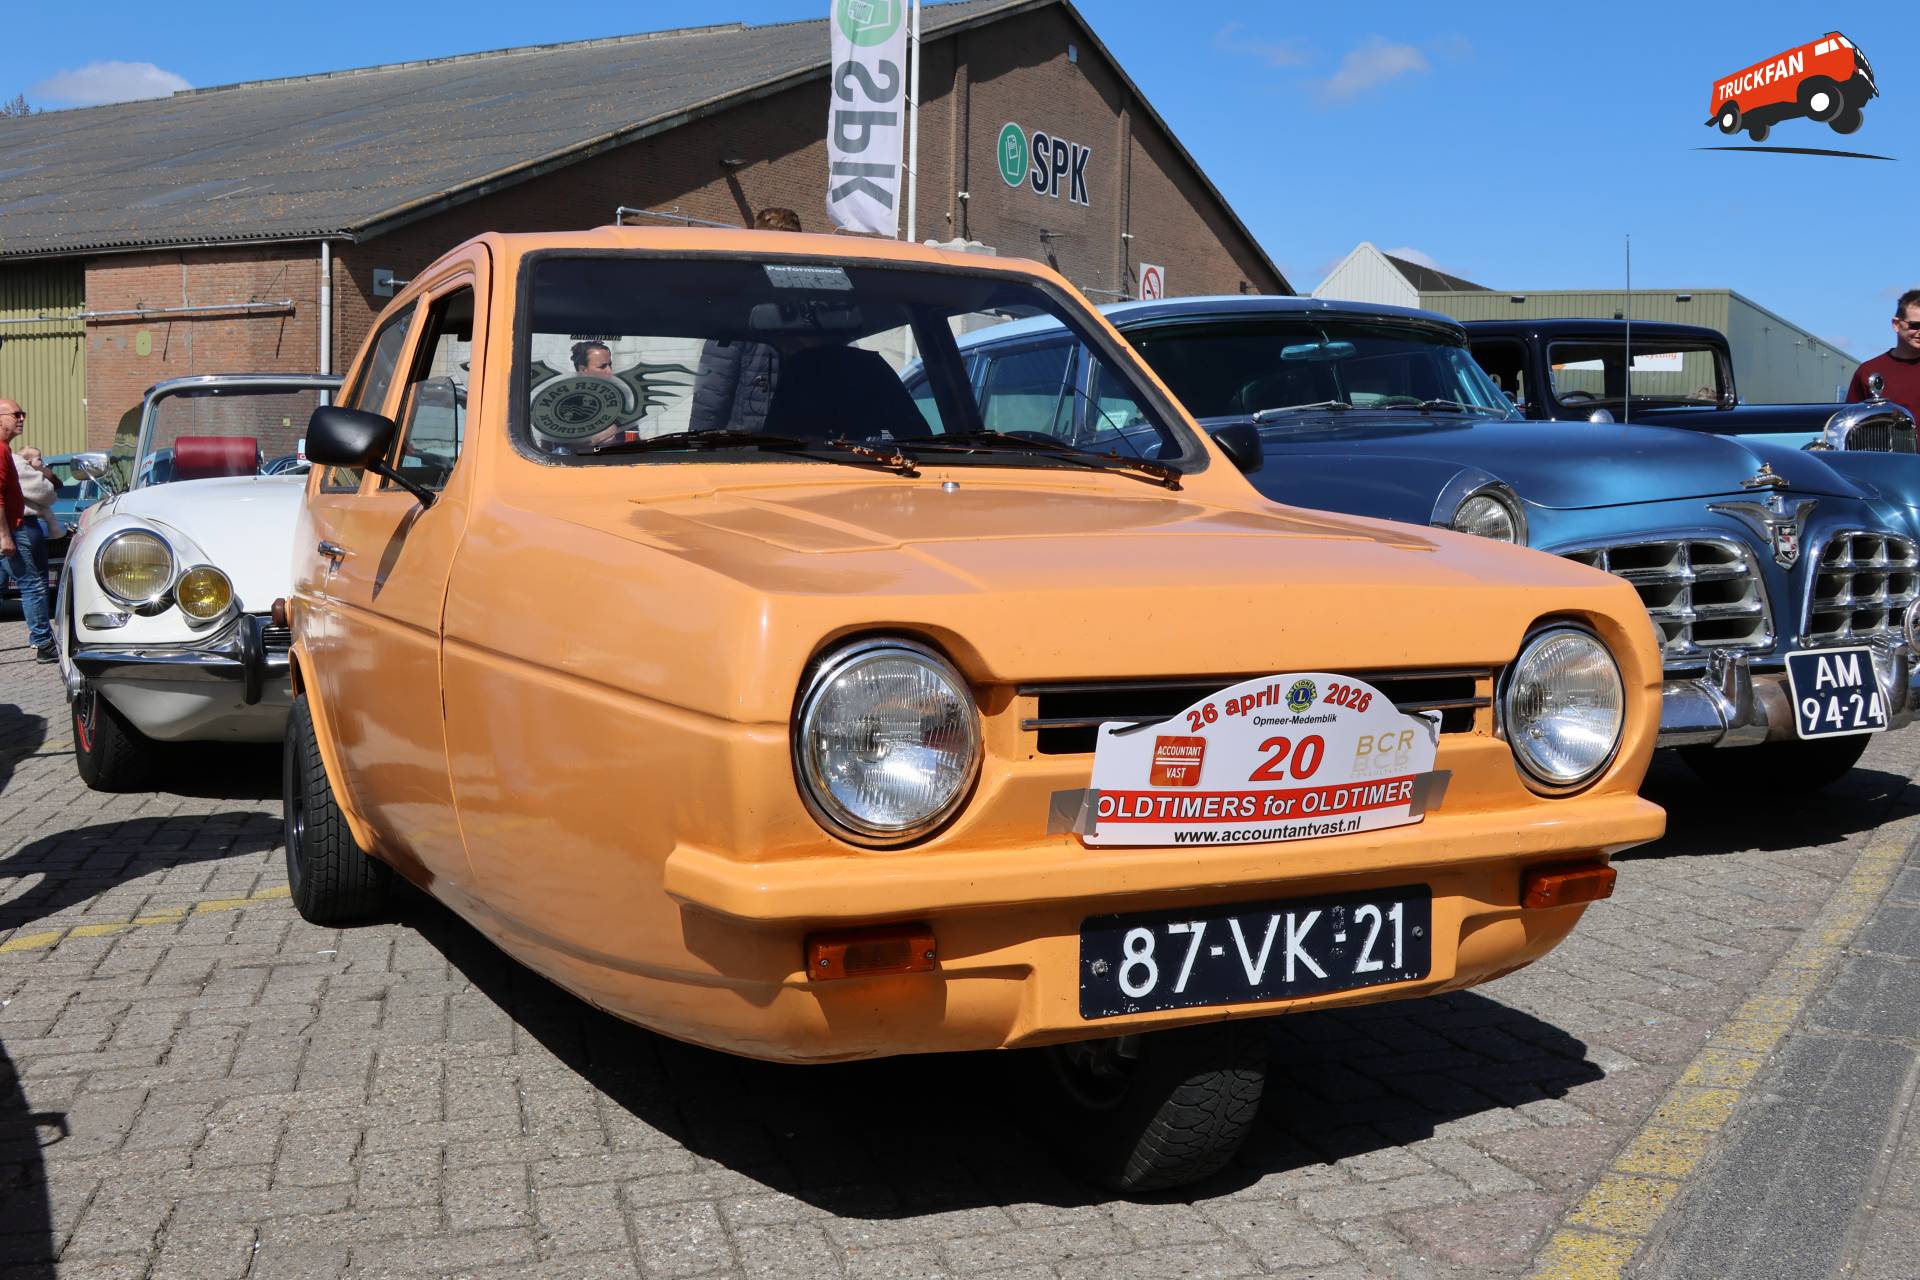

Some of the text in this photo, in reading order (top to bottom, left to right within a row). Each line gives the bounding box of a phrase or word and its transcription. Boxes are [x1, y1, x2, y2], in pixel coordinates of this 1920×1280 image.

[1030, 131, 1091, 206] SPK
[1816, 653, 1862, 690] AM
[1186, 683, 1373, 733] 26 april 2026
[1253, 714, 1337, 727] Opmeer-Medemblik
[1802, 692, 1884, 731] 94-24
[1157, 746, 1202, 756] ACCOUNTANT
[1248, 735, 1325, 781] 20
[1356, 729, 1415, 756] BCR
[1166, 768, 1186, 779] VAST
[1098, 780, 1413, 818] OLDTIMERS for OLDTIMER
[1174, 816, 1361, 843] www.accountantvast.nl
[1118, 902, 1403, 998] 87-VK-21
